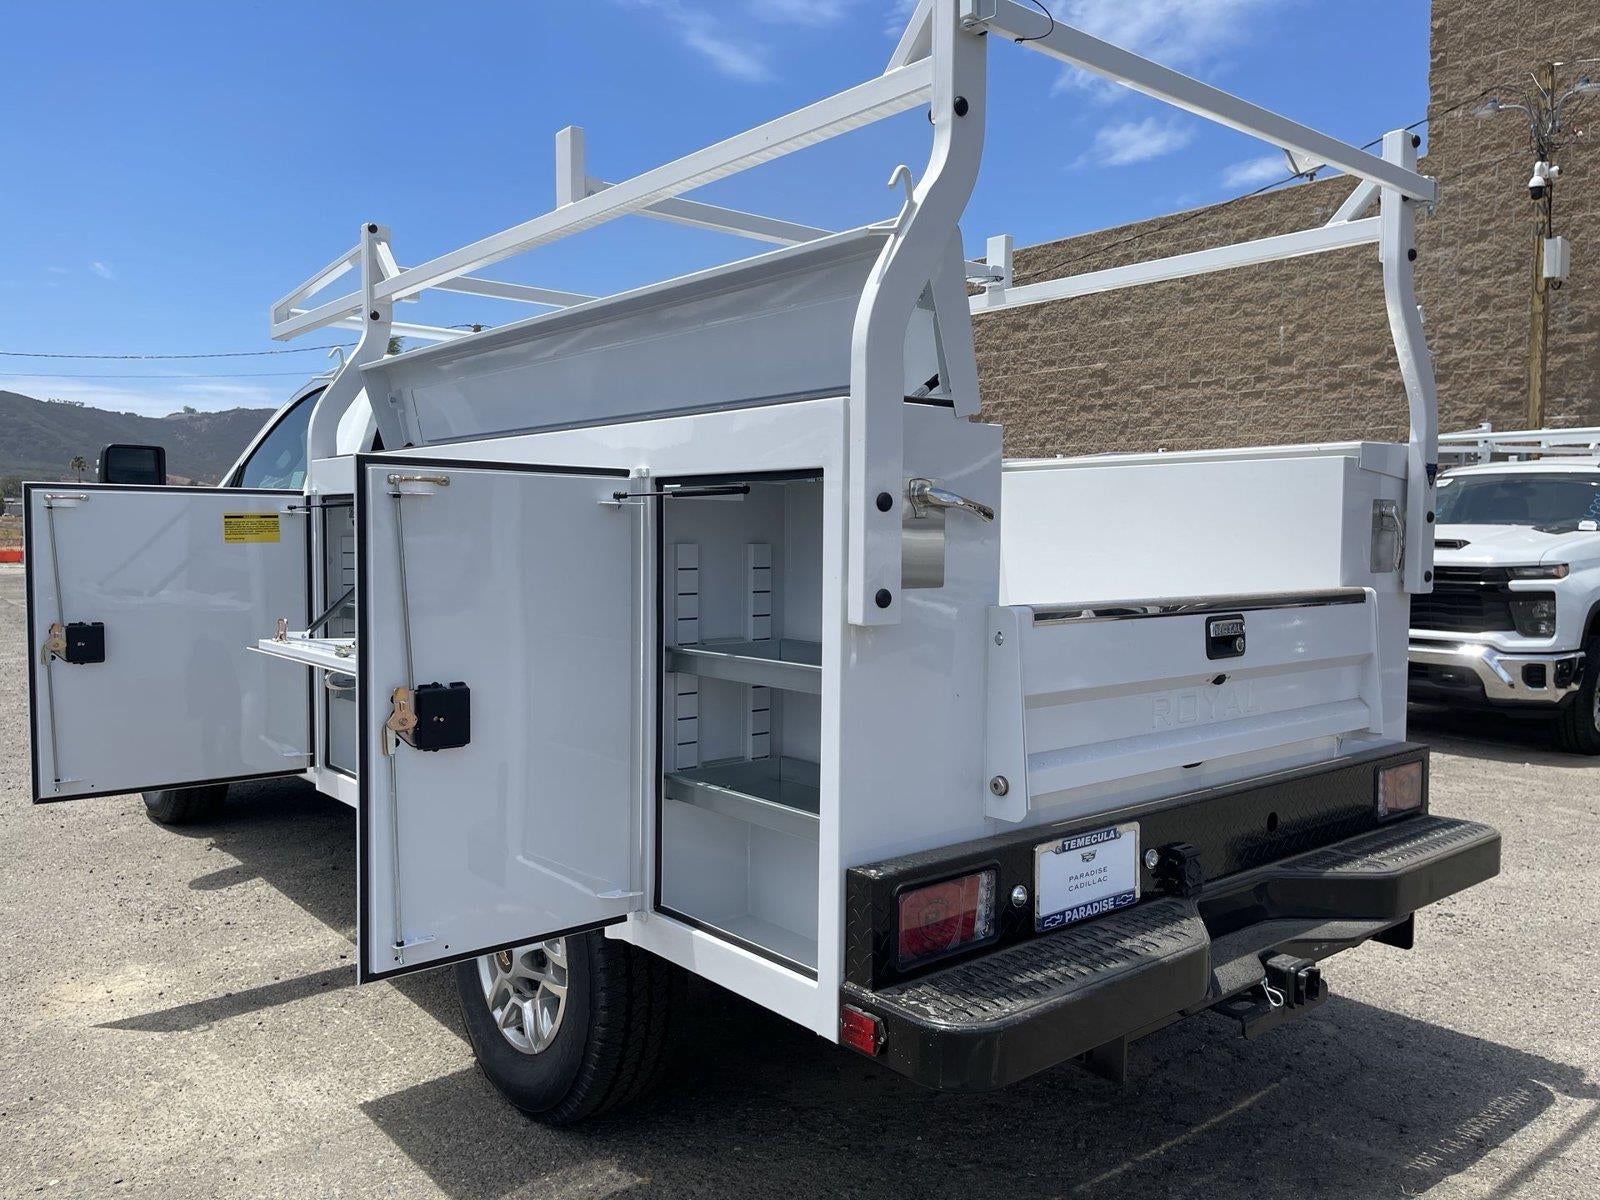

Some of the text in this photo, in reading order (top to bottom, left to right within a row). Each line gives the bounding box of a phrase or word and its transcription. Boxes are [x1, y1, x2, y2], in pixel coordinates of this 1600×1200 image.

[1152, 681, 1262, 728] ROYAL
[1064, 830, 1115, 850] TEMECULA
[1068, 866, 1108, 882] PARADISE
[1068, 876, 1108, 891] CADILLAC
[1065, 898, 1114, 922] PARADISE
